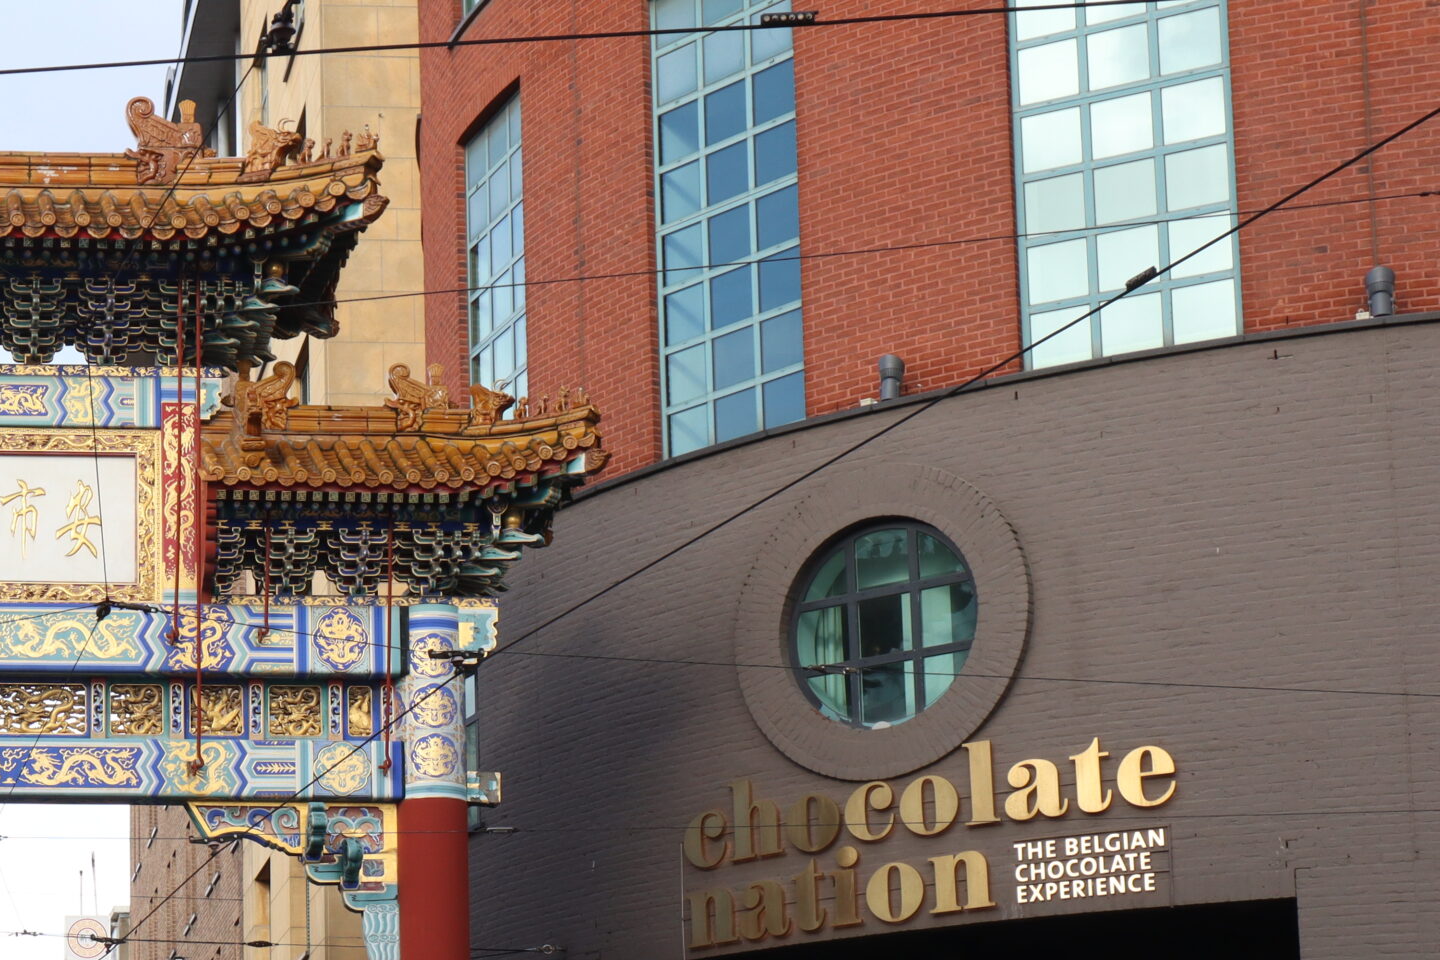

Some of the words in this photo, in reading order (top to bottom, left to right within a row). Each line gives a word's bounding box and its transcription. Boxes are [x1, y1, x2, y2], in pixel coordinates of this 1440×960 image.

[683, 737, 1177, 870] chocolate
[1013, 841, 1057, 863] THE
[1064, 828, 1166, 857] BELGIAN
[1014, 852, 1152, 883] CHOCOLATE
[688, 846, 998, 949] nation
[1016, 873, 1156, 904] EXPERIENCE
